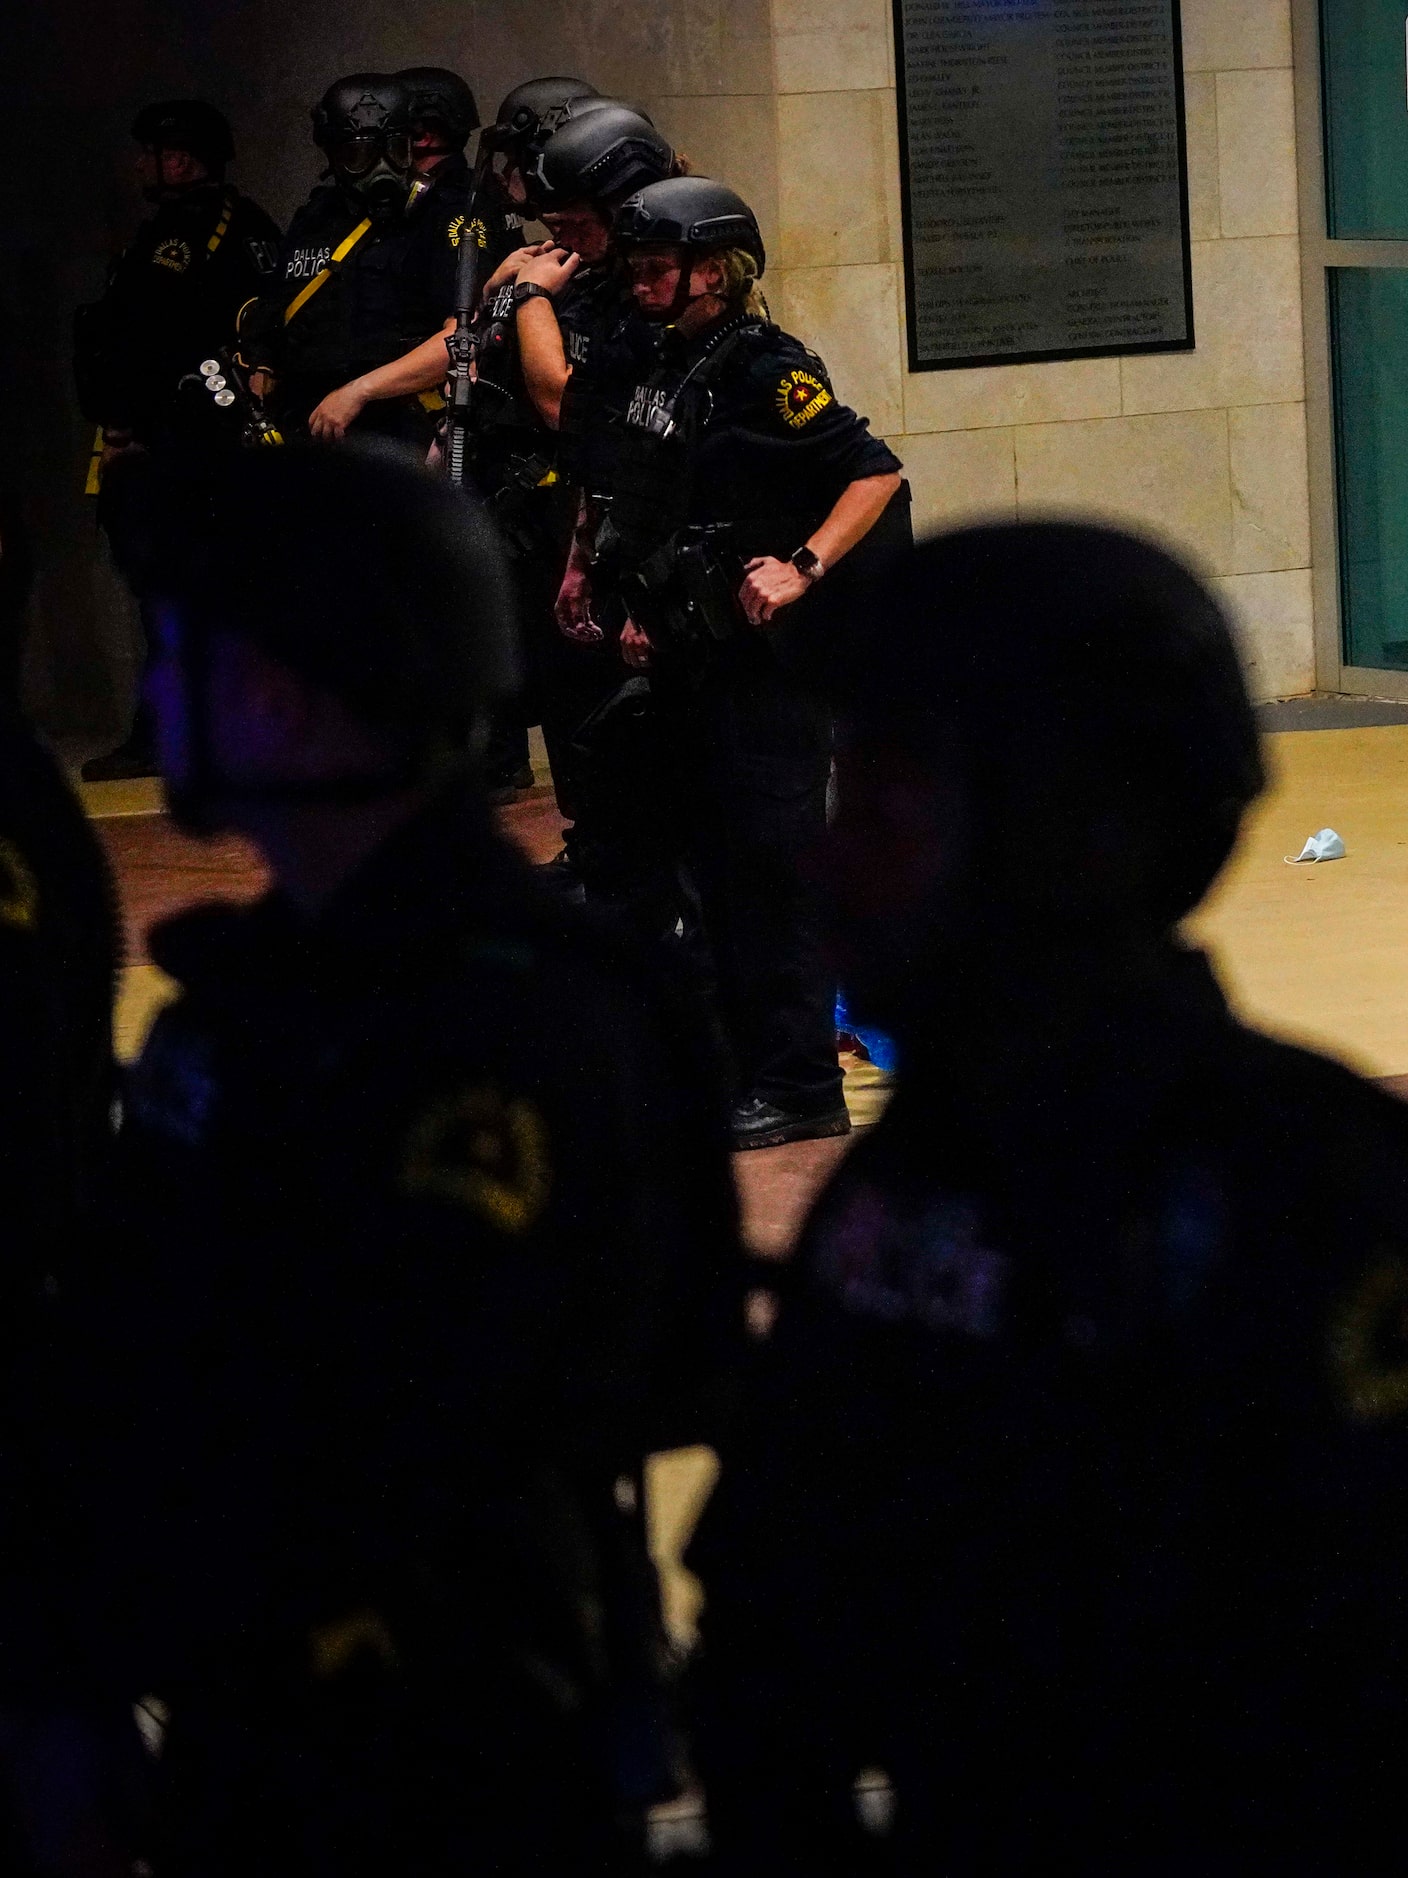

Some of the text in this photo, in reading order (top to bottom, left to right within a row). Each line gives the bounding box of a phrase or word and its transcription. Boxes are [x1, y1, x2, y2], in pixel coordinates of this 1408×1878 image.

[294, 247, 331, 262] DALLAS
[285, 259, 327, 279] POLIC
[791, 370, 823, 392] POLICE
[634, 385, 667, 407] DALLAS
